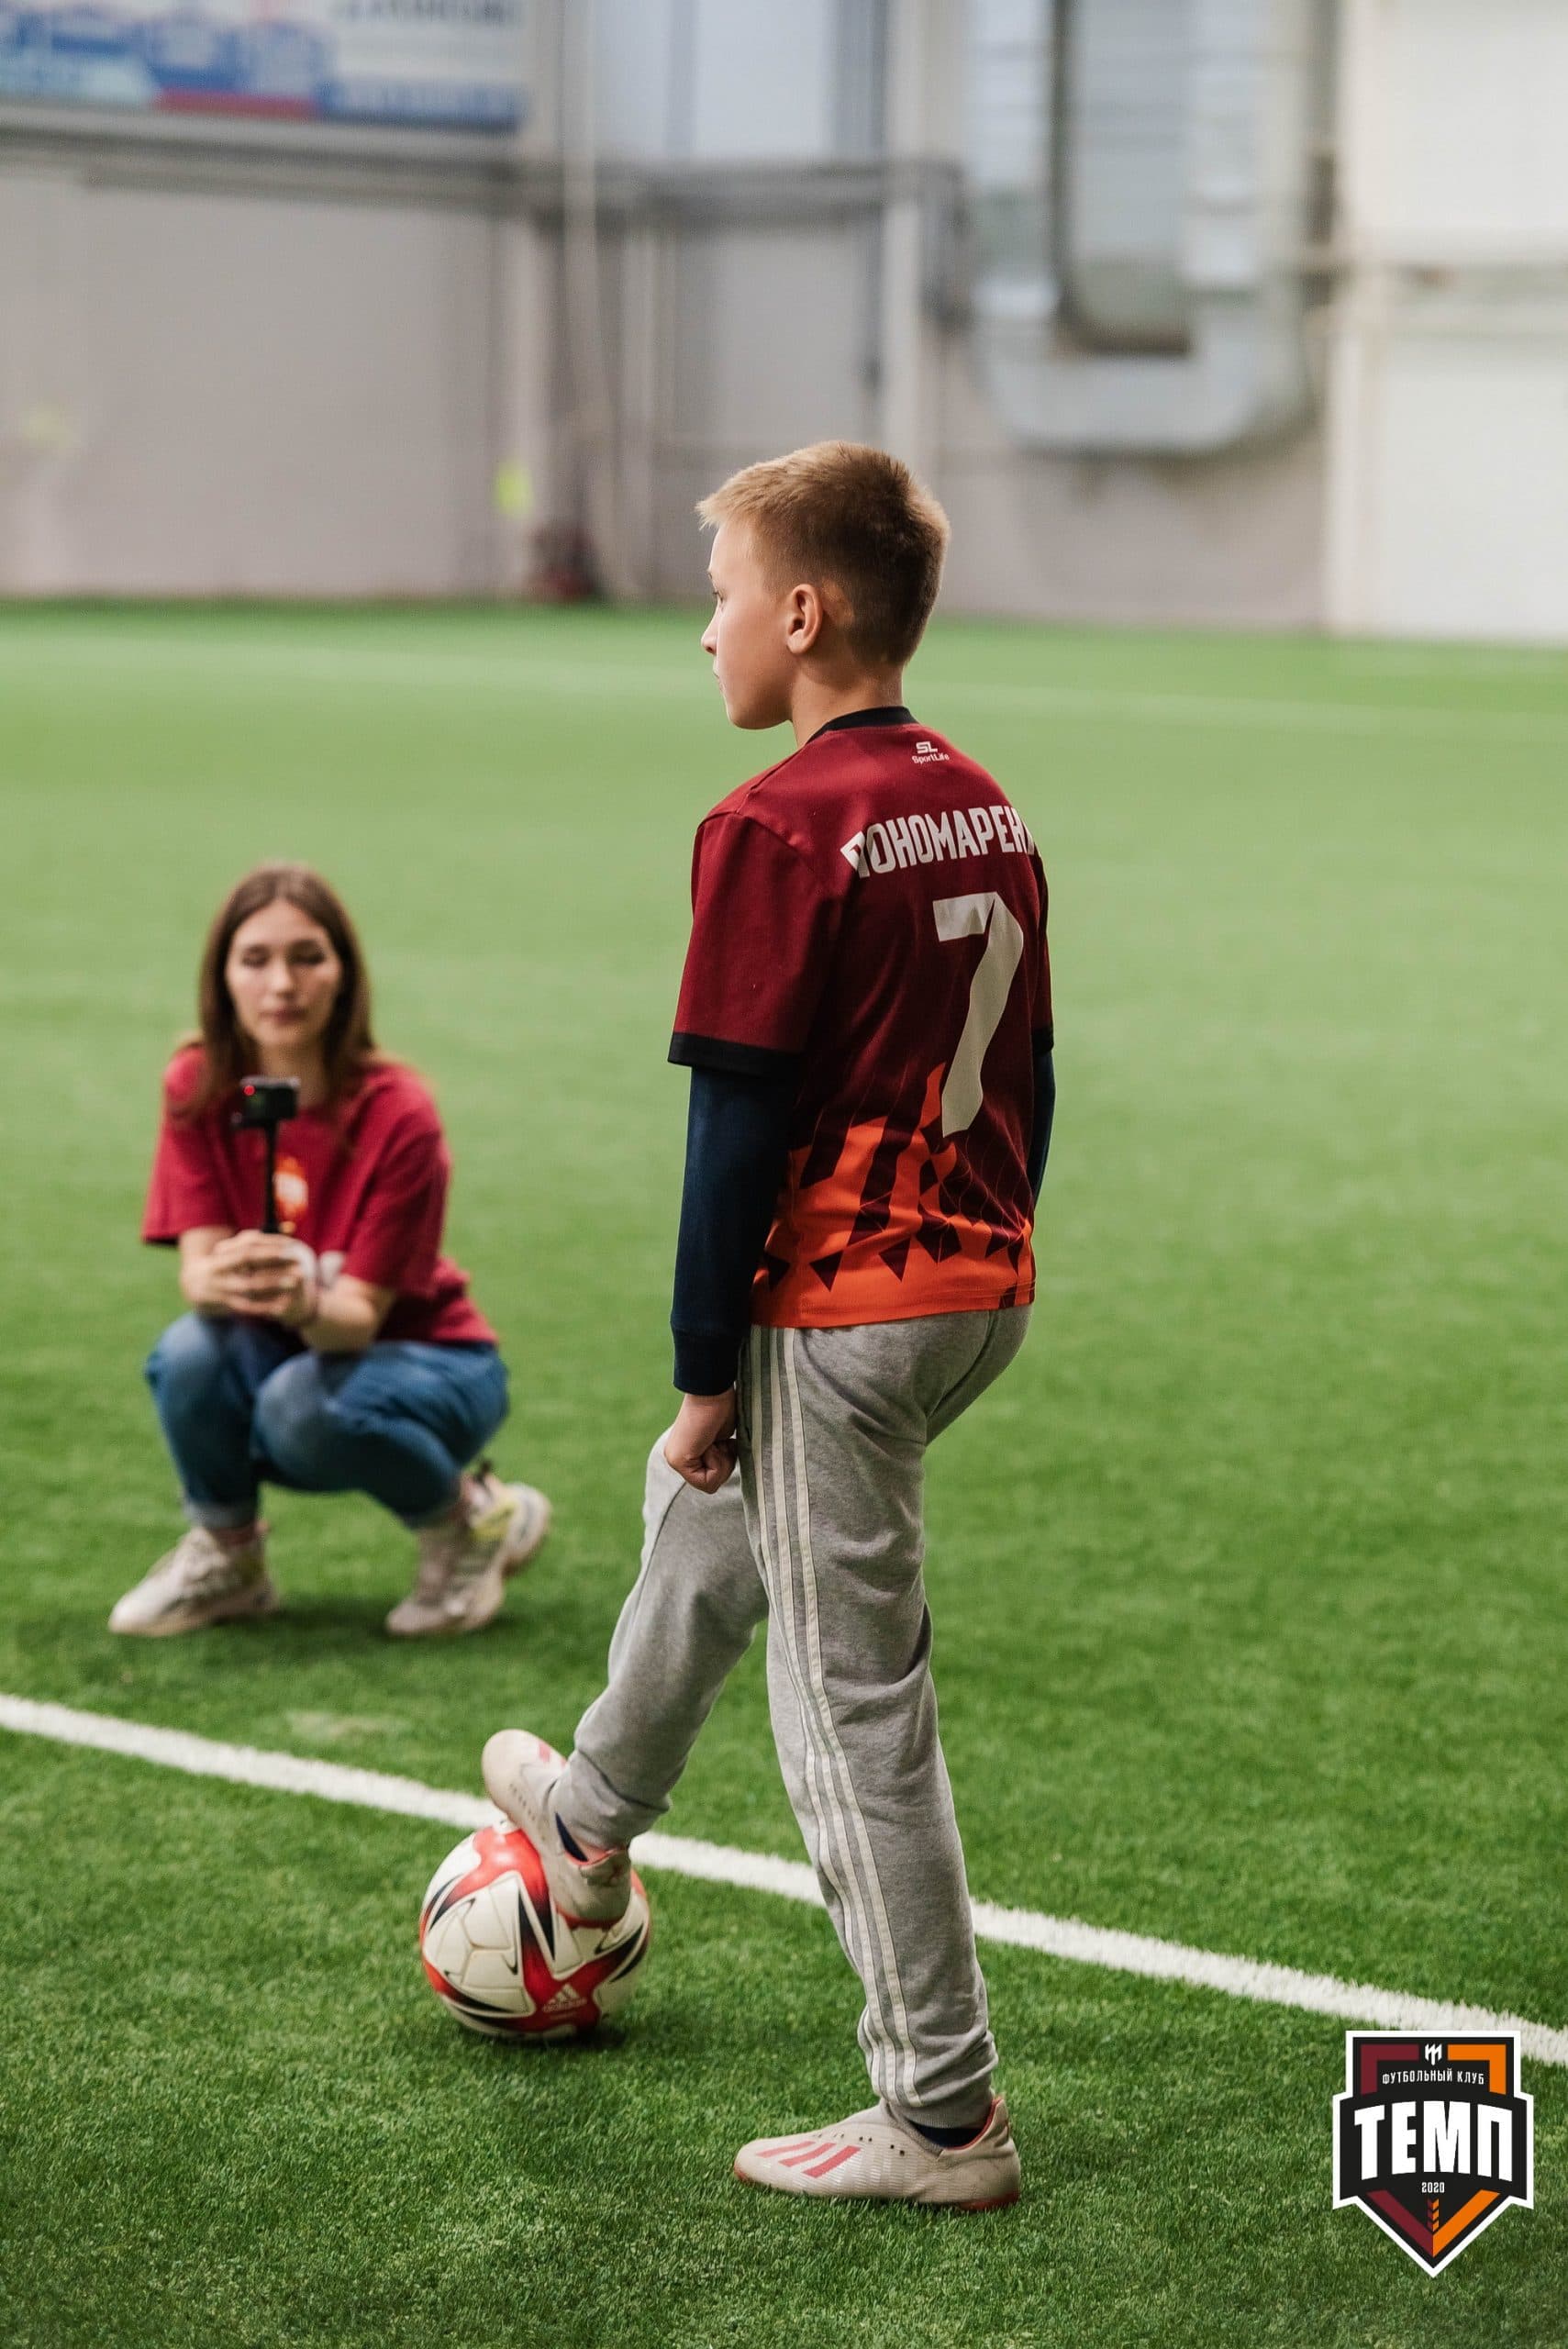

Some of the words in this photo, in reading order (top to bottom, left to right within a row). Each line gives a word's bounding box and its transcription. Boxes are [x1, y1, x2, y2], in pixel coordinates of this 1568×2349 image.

[916, 740, 939, 754] SL
[911, 752, 951, 765] SportLife
[931, 891, 1024, 1139] 7
